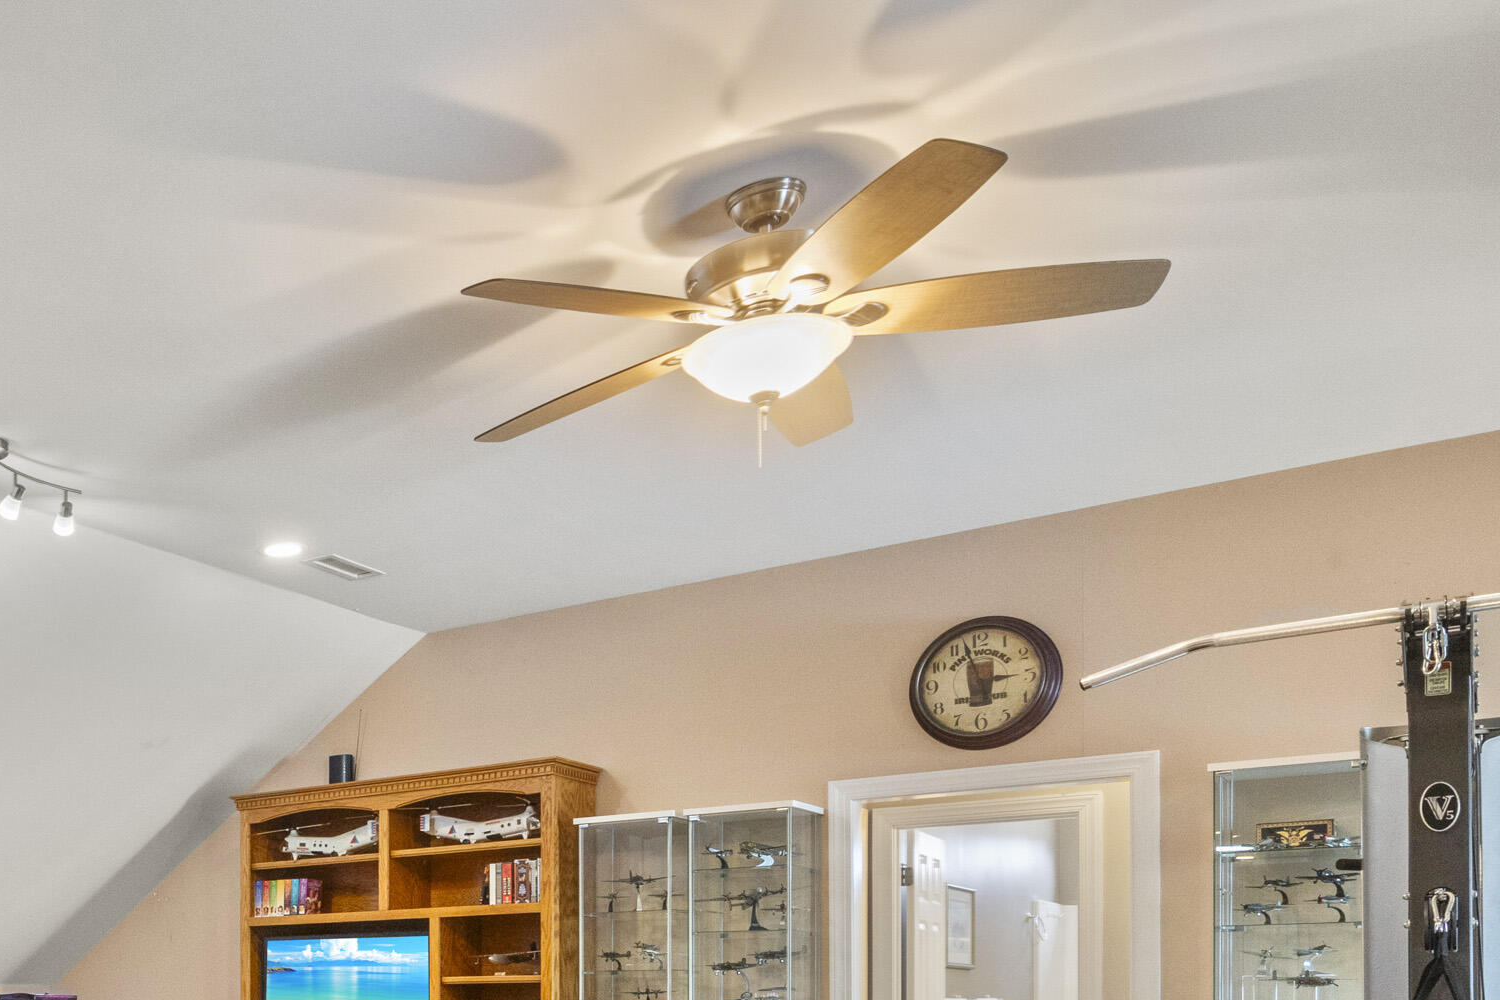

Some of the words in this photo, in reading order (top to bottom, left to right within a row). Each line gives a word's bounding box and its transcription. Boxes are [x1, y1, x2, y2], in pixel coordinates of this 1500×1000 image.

[972, 632, 988, 648] 12
[951, 645, 959, 656] 11
[973, 649, 1012, 664] WORKS
[1018, 647, 1029, 660] 2
[932, 660, 947, 674] 10
[1024, 666, 1037, 683] 3
[925, 680, 939, 695] 9
[933, 702, 944, 715] 8
[999, 708, 1011, 722] 5
[953, 712, 964, 727] 7
[974, 712, 988, 731] 6
